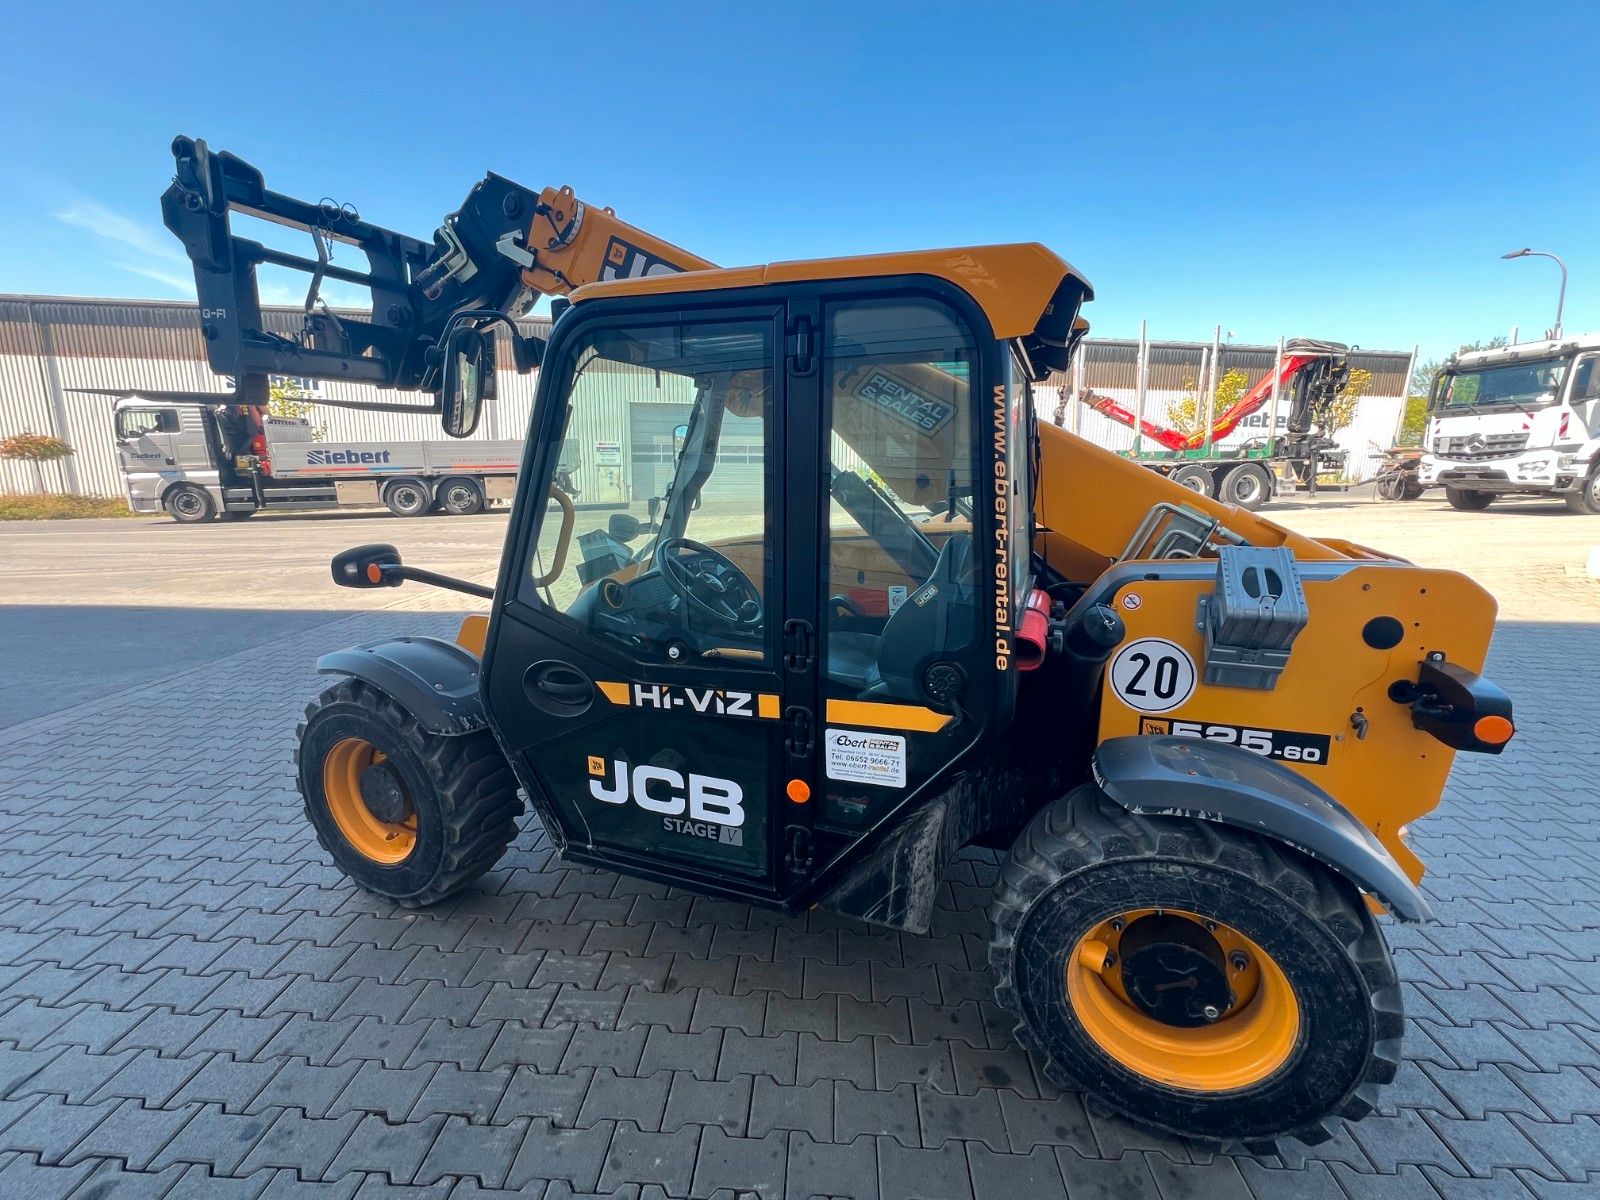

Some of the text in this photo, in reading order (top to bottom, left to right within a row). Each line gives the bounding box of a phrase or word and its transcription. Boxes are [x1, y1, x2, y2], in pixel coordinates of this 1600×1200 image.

[861, 386, 936, 429] & SALES
[871, 374, 944, 419] RENTAL
[307, 450, 391, 465] Siebert
[993, 384, 1010, 672] www.ebert-rental.de
[918, 587, 936, 604] JCB
[1125, 652, 1179, 699] 20
[836, 735, 867, 749] Ebert
[846, 754, 869, 763] 06652
[589, 759, 745, 827] JCB
[663, 817, 717, 840] STAGE
